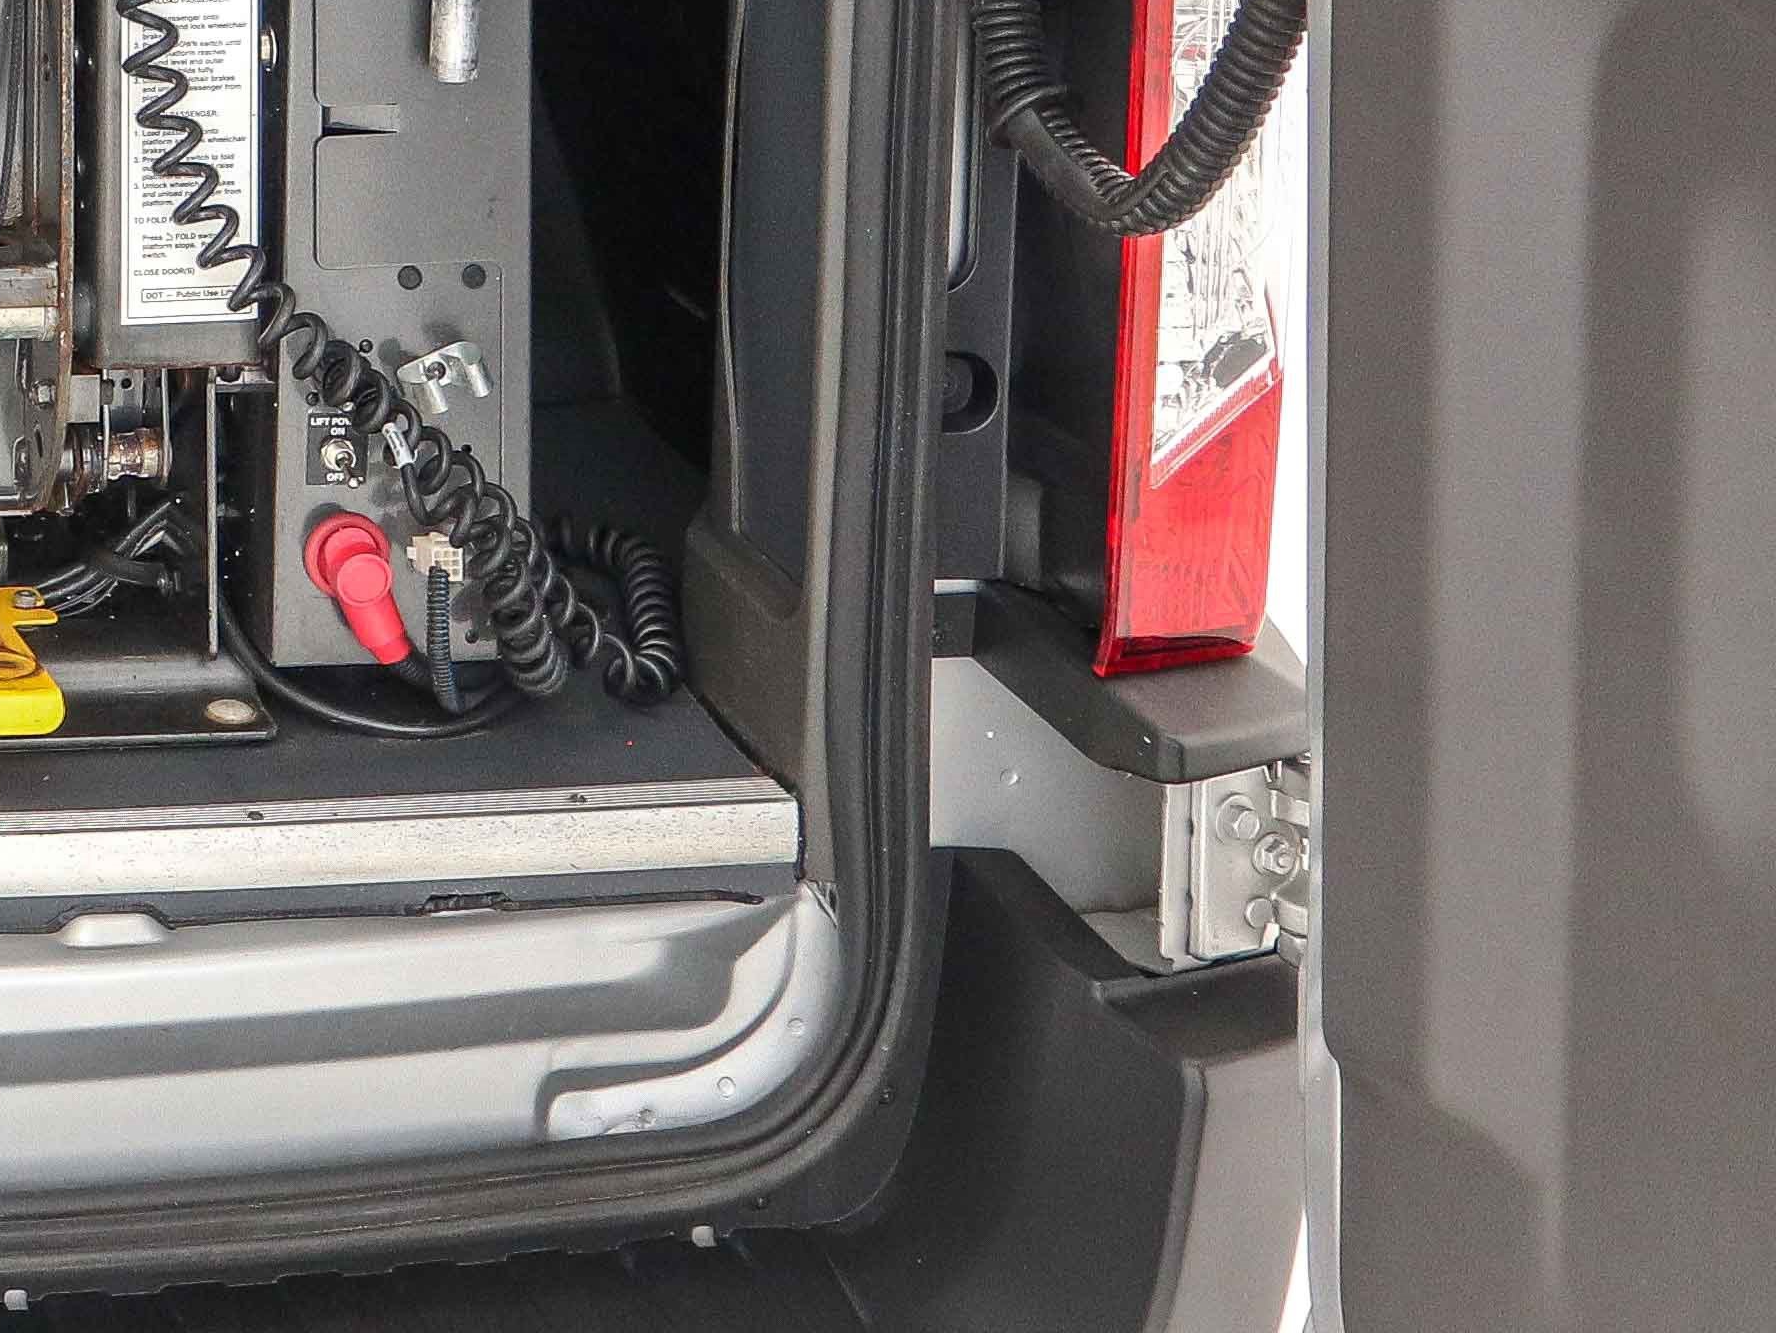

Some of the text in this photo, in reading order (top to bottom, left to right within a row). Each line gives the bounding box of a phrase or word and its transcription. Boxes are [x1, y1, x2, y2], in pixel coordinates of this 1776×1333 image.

[310, 417, 330, 426] LIFT
[330, 427, 345, 435] ON
[326, 473, 345, 482] OFF
